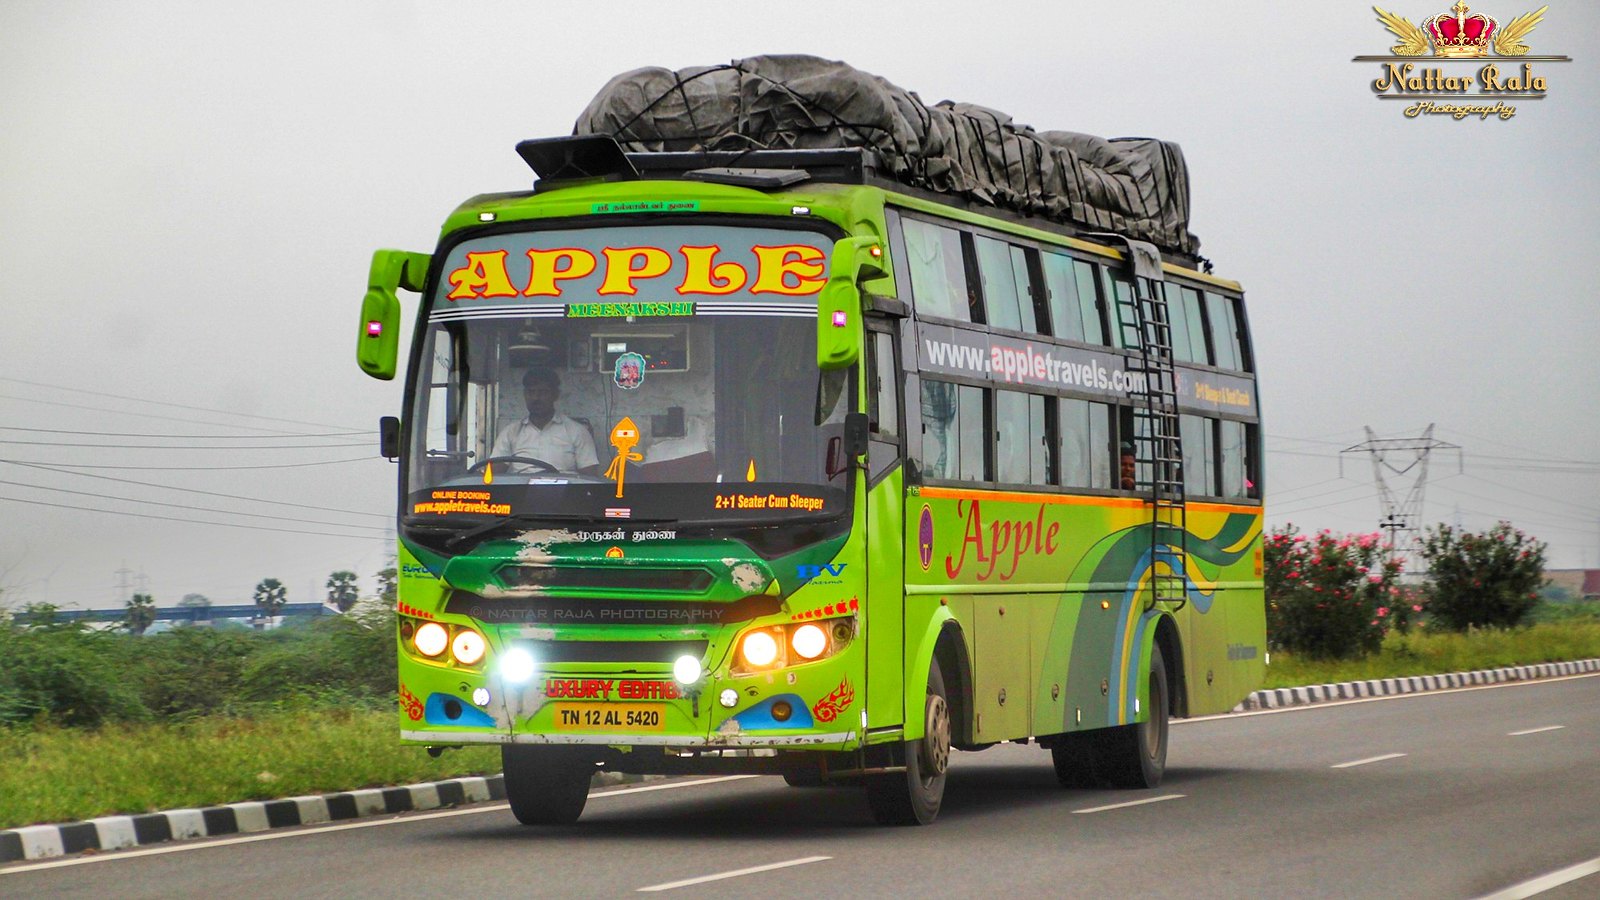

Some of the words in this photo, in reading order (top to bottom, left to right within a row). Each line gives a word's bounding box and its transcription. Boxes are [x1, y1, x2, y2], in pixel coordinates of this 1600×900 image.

[446, 244, 828, 302] APPLE
[567, 302, 693, 317] MEENAKSHI
[925, 339, 1150, 395] www.appletravels.com
[431, 490, 457, 500] ONLINE
[457, 491, 491, 500] BOOKING
[715, 494, 736, 509] 2+1
[737, 494, 767, 509] Seater
[768, 494, 788, 508] Cum
[790, 493, 824, 511] Sleeper
[414, 500, 511, 515] www.appletravels.com
[577, 528, 625, 543] முருகன்
[632, 530, 676, 543] துணை
[945, 499, 1060, 582] Apple
[618, 680, 687, 699] EDITIO
[561, 710, 580, 725] TN
[584, 710, 601, 725] 12
[604, 710, 622, 726] AL
[626, 710, 659, 726] 5420
